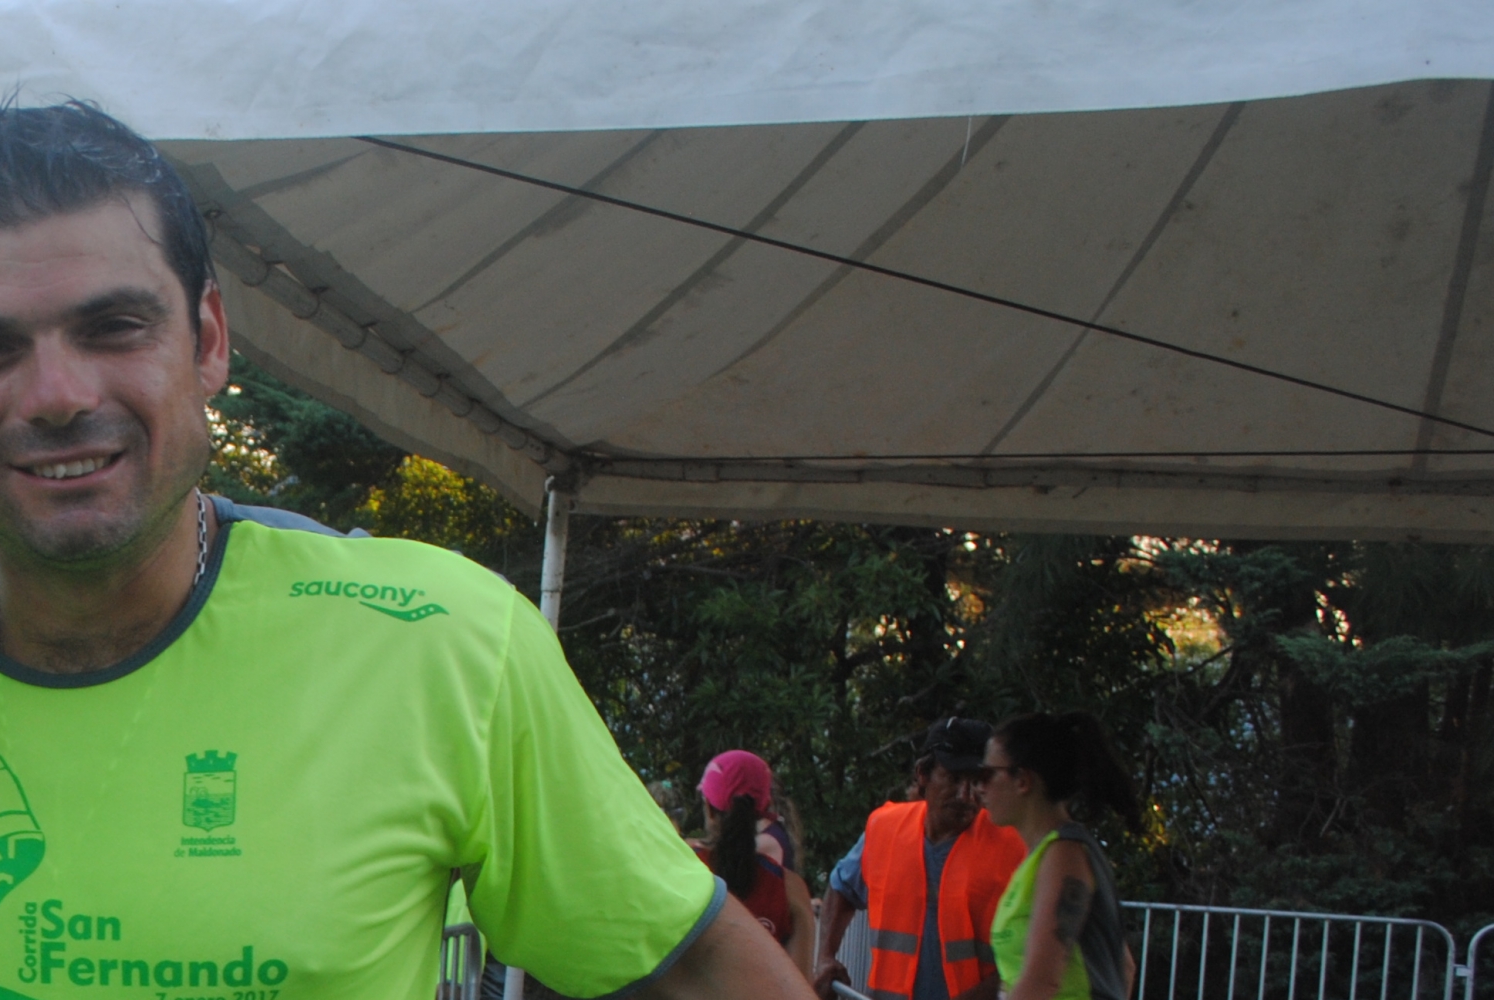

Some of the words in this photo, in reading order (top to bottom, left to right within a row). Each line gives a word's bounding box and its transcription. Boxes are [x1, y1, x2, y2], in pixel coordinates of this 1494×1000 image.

[288, 579, 418, 608] saucony
[173, 848, 186, 858] de
[188, 847, 242, 857] Maldonado
[41, 898, 121, 941] San
[18, 901, 37, 984] Corrida
[40, 942, 289, 988] Fernando
